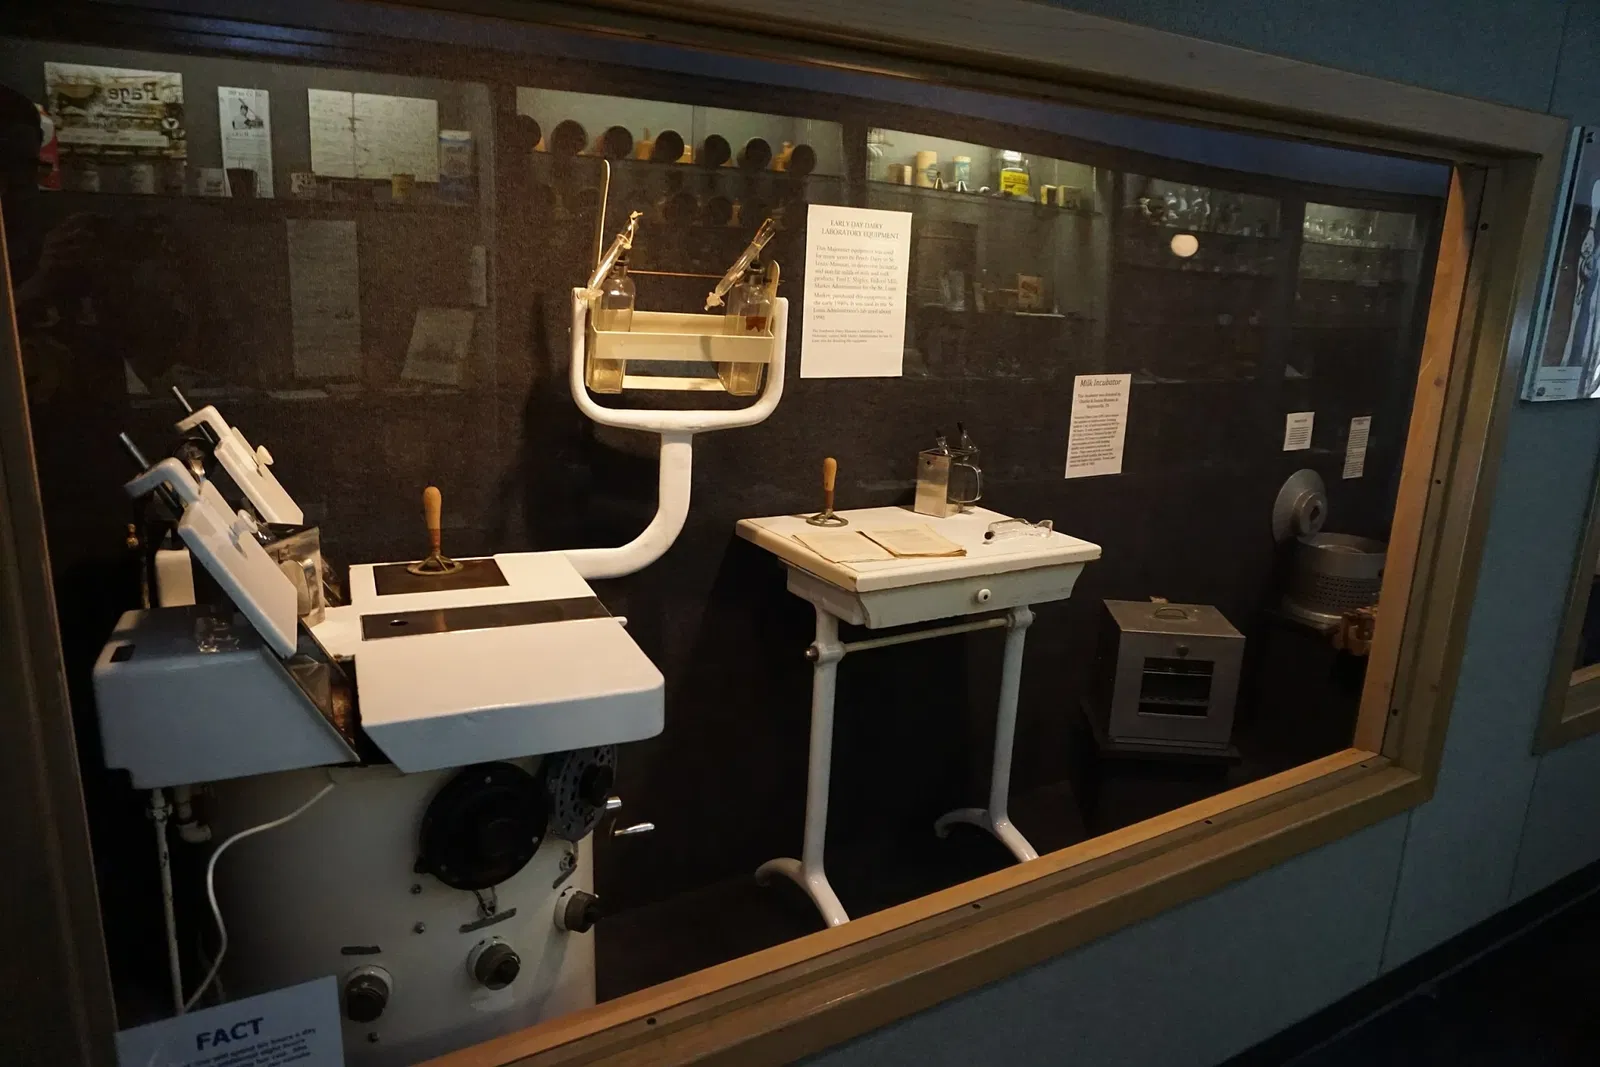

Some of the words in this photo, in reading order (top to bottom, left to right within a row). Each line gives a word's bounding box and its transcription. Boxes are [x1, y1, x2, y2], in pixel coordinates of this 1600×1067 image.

[822, 228, 862, 236] LABORATORY
[864, 231, 899, 239] EQUIPMENT
[196, 1016, 264, 1051] FACT
